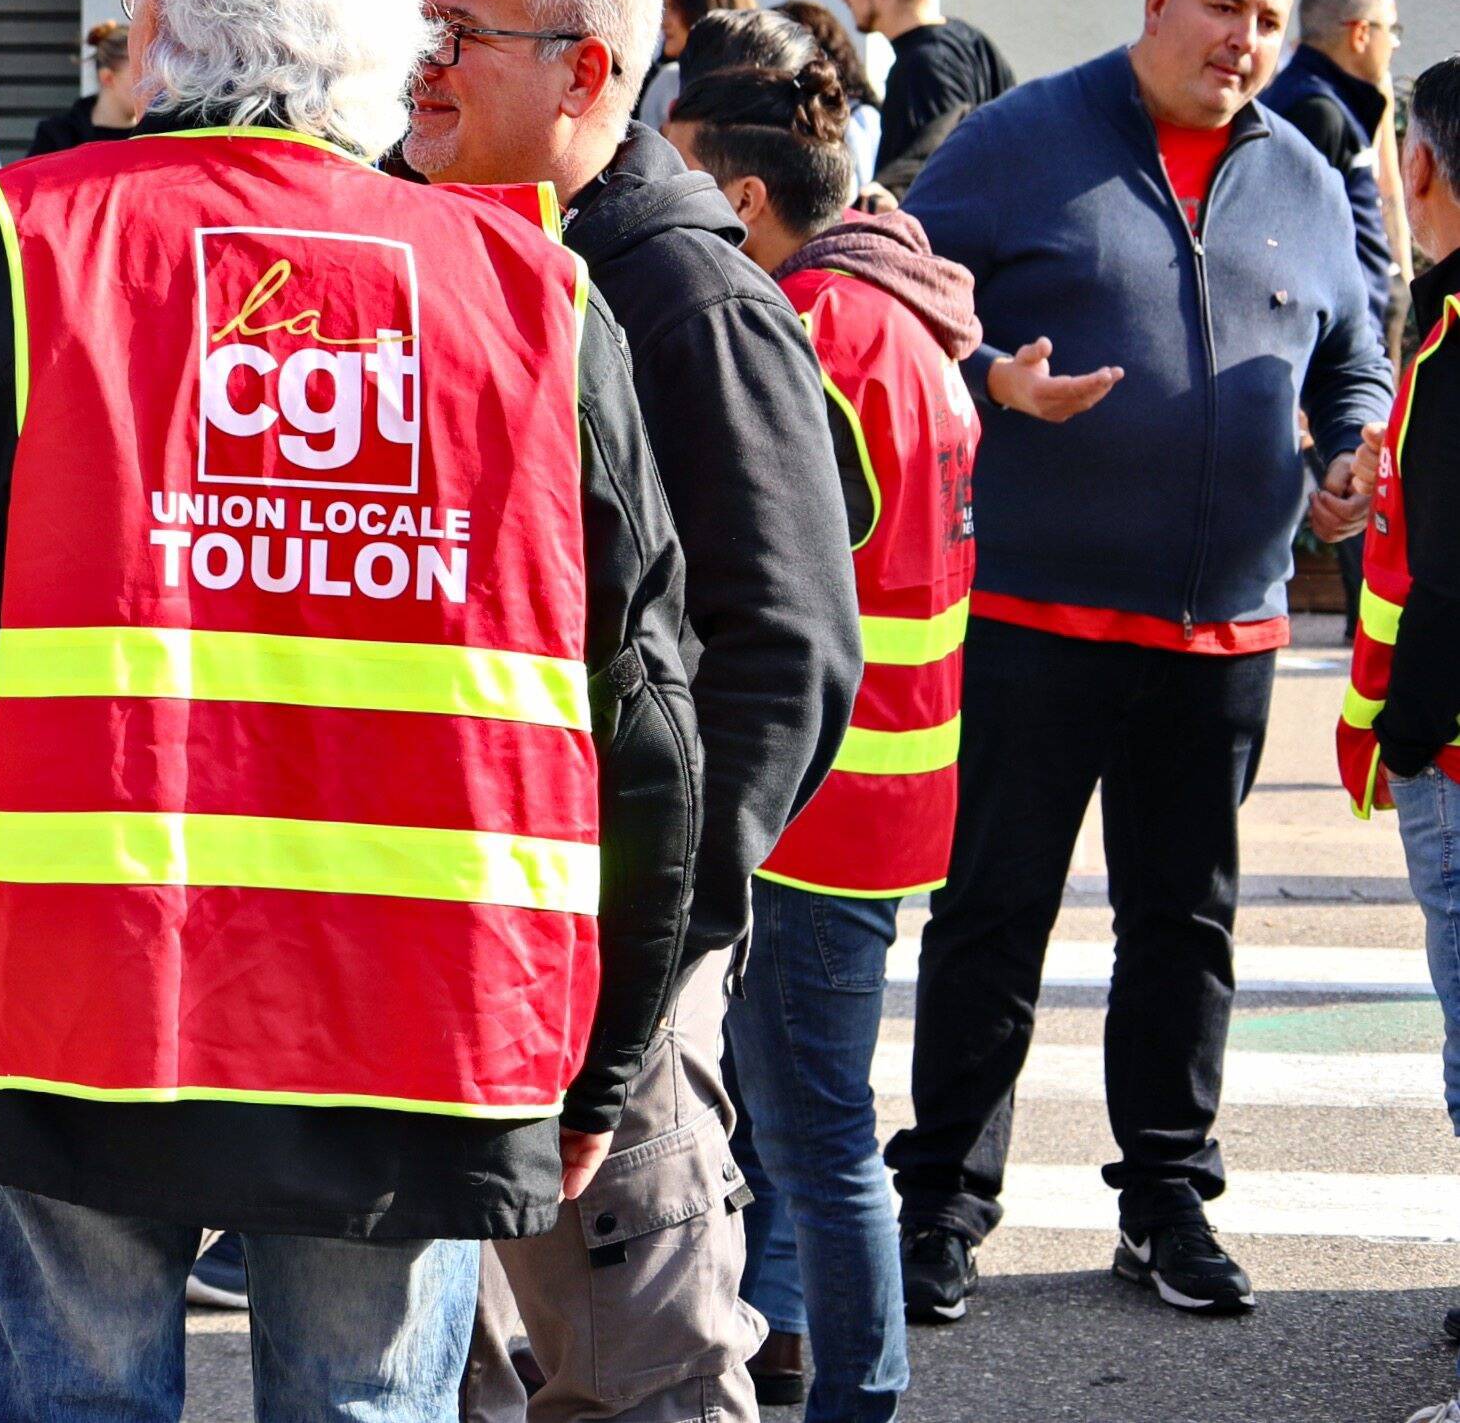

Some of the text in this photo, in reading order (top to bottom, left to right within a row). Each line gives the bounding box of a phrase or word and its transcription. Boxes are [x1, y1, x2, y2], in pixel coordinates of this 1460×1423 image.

[206, 328, 420, 470] cgt
[151, 490, 471, 541] UNION LOCALE
[149, 529, 469, 604] TOULON
